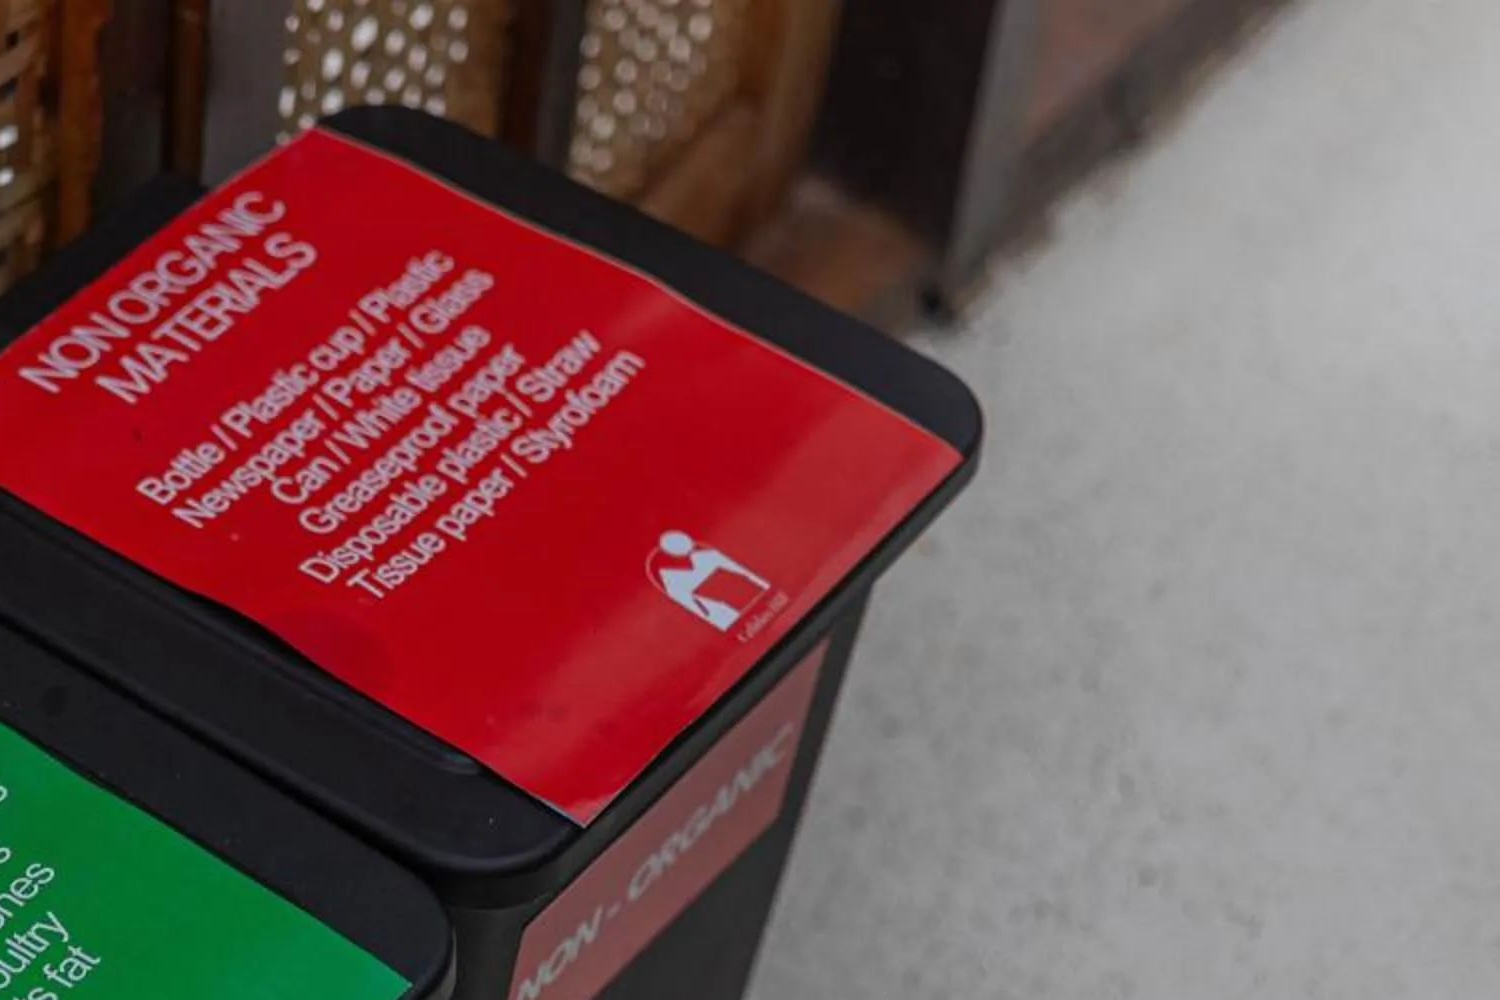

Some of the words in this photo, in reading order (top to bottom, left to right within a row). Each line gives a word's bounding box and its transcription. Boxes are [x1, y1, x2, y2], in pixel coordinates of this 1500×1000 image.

[95, 233, 317, 404] MATERIALS
[357, 251, 454, 323] Plastic
[409, 269, 494, 334] Glass
[308, 326, 365, 371] cup
[348, 309, 377, 337] /
[396, 323, 425, 349] /
[322, 337, 411, 408] Paper
[404, 325, 491, 393] tissue
[515, 330, 601, 403] Straw
[220, 363, 320, 438] Plastic
[312, 393, 339, 421] /
[331, 387, 422, 449] White
[504, 391, 533, 419] /
[510, 351, 645, 464] Styrofoam
[171, 408, 326, 529] Newspaper
[211, 424, 238, 451] /
[298, 402, 459, 534] Greaseproof
[447, 343, 525, 420] paper
[323, 439, 351, 465] /
[435, 408, 519, 484] plastic
[499, 453, 528, 478] /
[135, 442, 226, 505] Bottle
[269, 455, 341, 504] Can
[435, 467, 514, 542] paper
[298, 474, 448, 584] Disposable
[346, 532, 446, 599] Tissue
[626, 722, 794, 903] ORGANIC
[42, 945, 101, 988] fat
